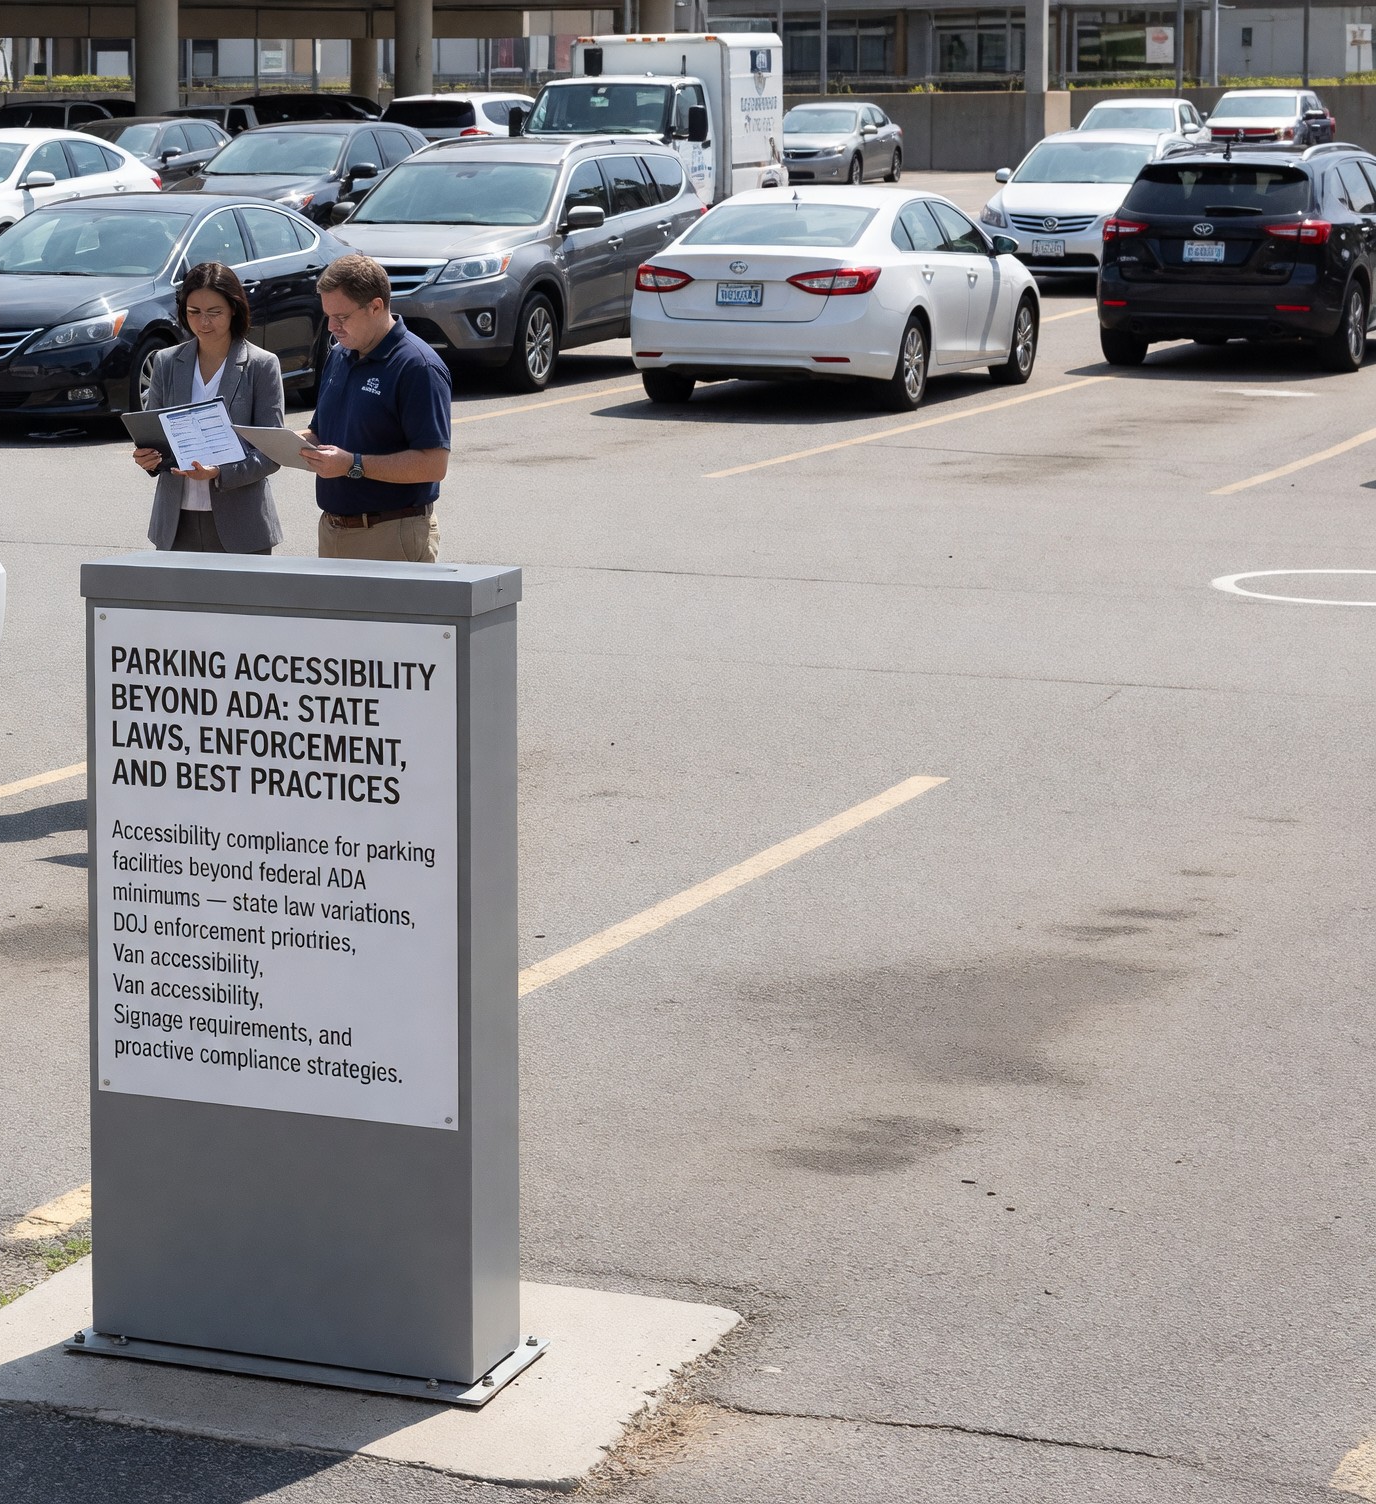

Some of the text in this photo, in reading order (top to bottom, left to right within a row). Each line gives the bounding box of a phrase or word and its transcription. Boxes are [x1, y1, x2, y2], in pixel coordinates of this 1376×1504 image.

[111, 645, 437, 692] PARKING ACCESSIBILITY
[111, 683, 380, 727] BEYOND ADA: STATE
[112, 720, 407, 773] LAWS, ENFORCEMENT,
[111, 758, 401, 805] AND BEST PRACTICES
[111, 819, 436, 869] Accessibility compliance for parking
[111, 849, 367, 891] facilities beyond federal ADA
[112, 881, 201, 908] minimums
[232, 892, 278, 915] state
[284, 894, 316, 918] law
[320, 900, 415, 930] variations,
[113, 911, 148, 934] DOJ
[153, 916, 266, 945] enforcement
[112, 942, 264, 980] Van accessibility,
[112, 972, 263, 1012] Van accessibility,
[113, 1003, 352, 1048] Signage requirements, and
[114, 1038, 403, 1085] proactive compliance strategies.
